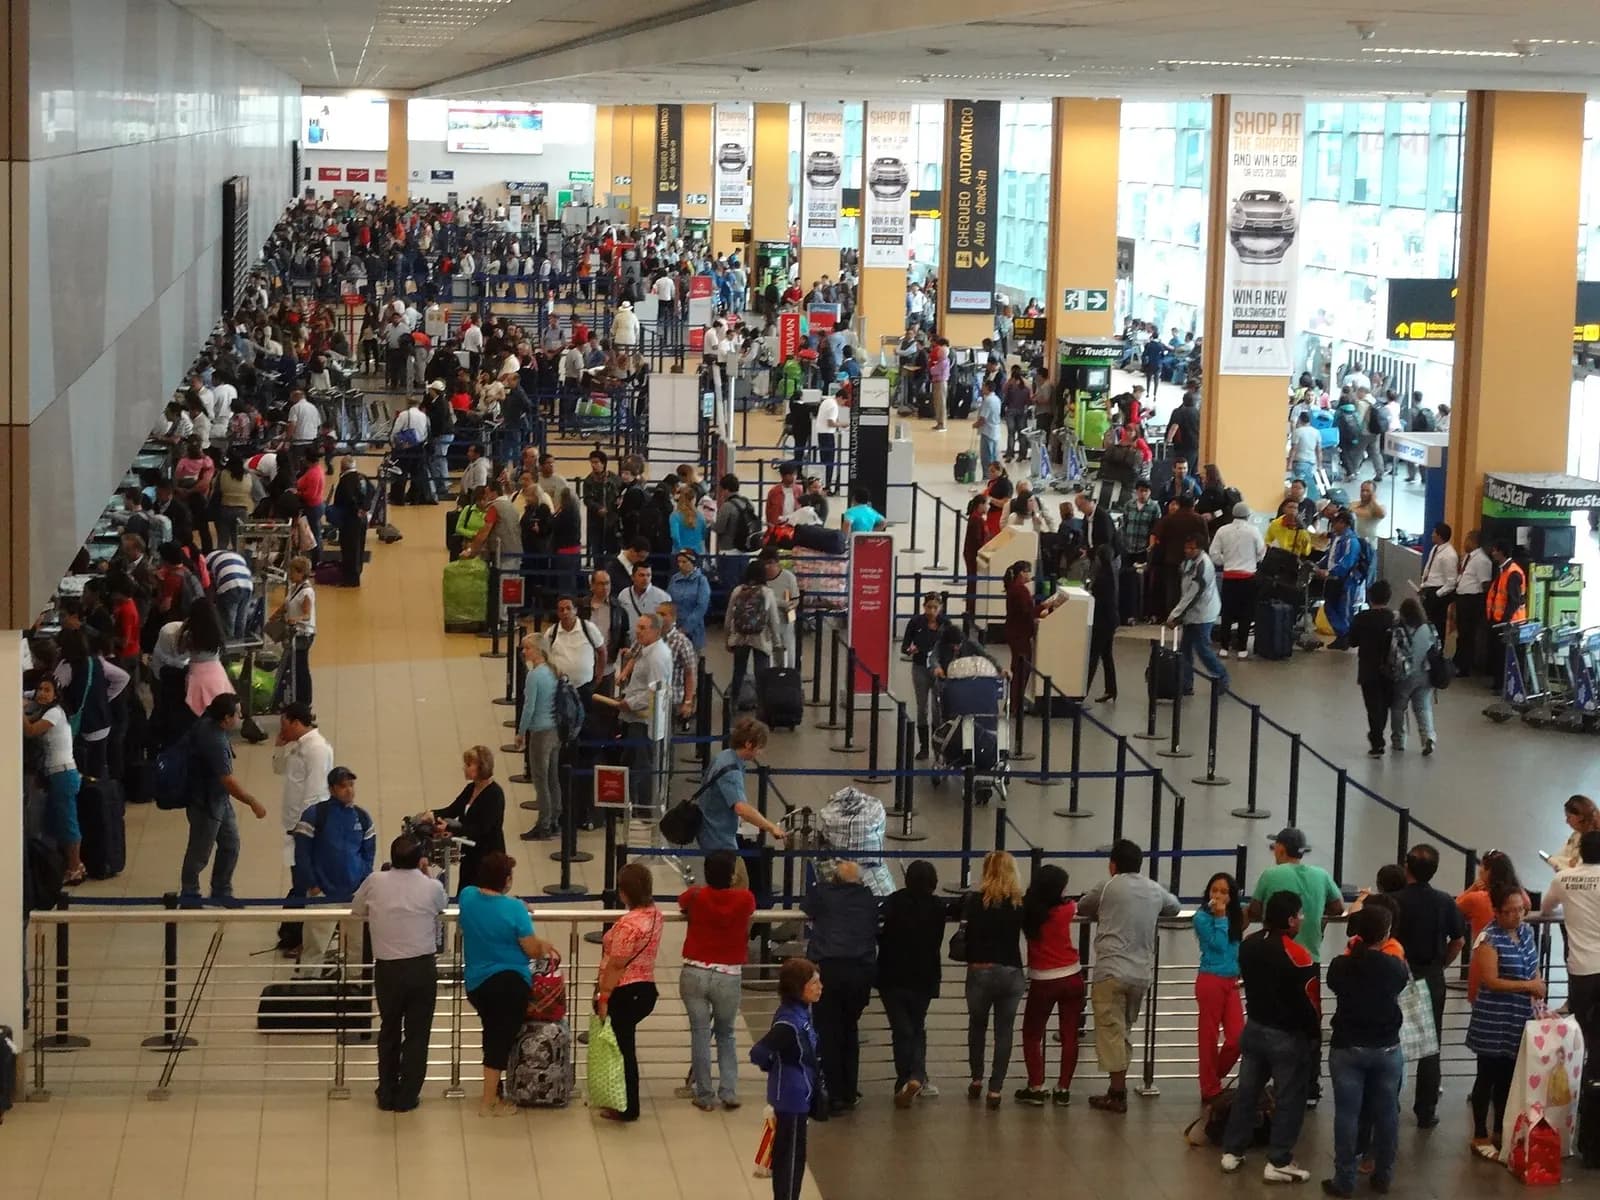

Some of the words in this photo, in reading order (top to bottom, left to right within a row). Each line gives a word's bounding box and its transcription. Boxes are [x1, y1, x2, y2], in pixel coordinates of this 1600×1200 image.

[870, 111, 896, 125] SHOP
[899, 111, 911, 125] AT
[1234, 112, 1278, 135] SHOP
[1282, 112, 1302, 136] AT
[959, 107, 974, 185] AUTOMÁTICO
[1234, 153, 1251, 167] AND
[1254, 154, 1270, 167] WIN
[1272, 154, 1279, 167] A
[1280, 154, 1298, 168] CAR
[975, 169, 987, 215] check-in
[957, 192, 971, 247] CHEQUEO
[973, 221, 986, 247] Auto
[1232, 289, 1253, 305] WIN
[1255, 289, 1262, 305] A
[1264, 290, 1287, 305] NEW
[1232, 307, 1277, 318] VOLKSWAGEN
[1277, 307, 1287, 318] CC
[1085, 346, 1122, 356] TrueStar
[1488, 479, 1531, 507] TrueStar
[1554, 494, 1600, 507] TrueSta
